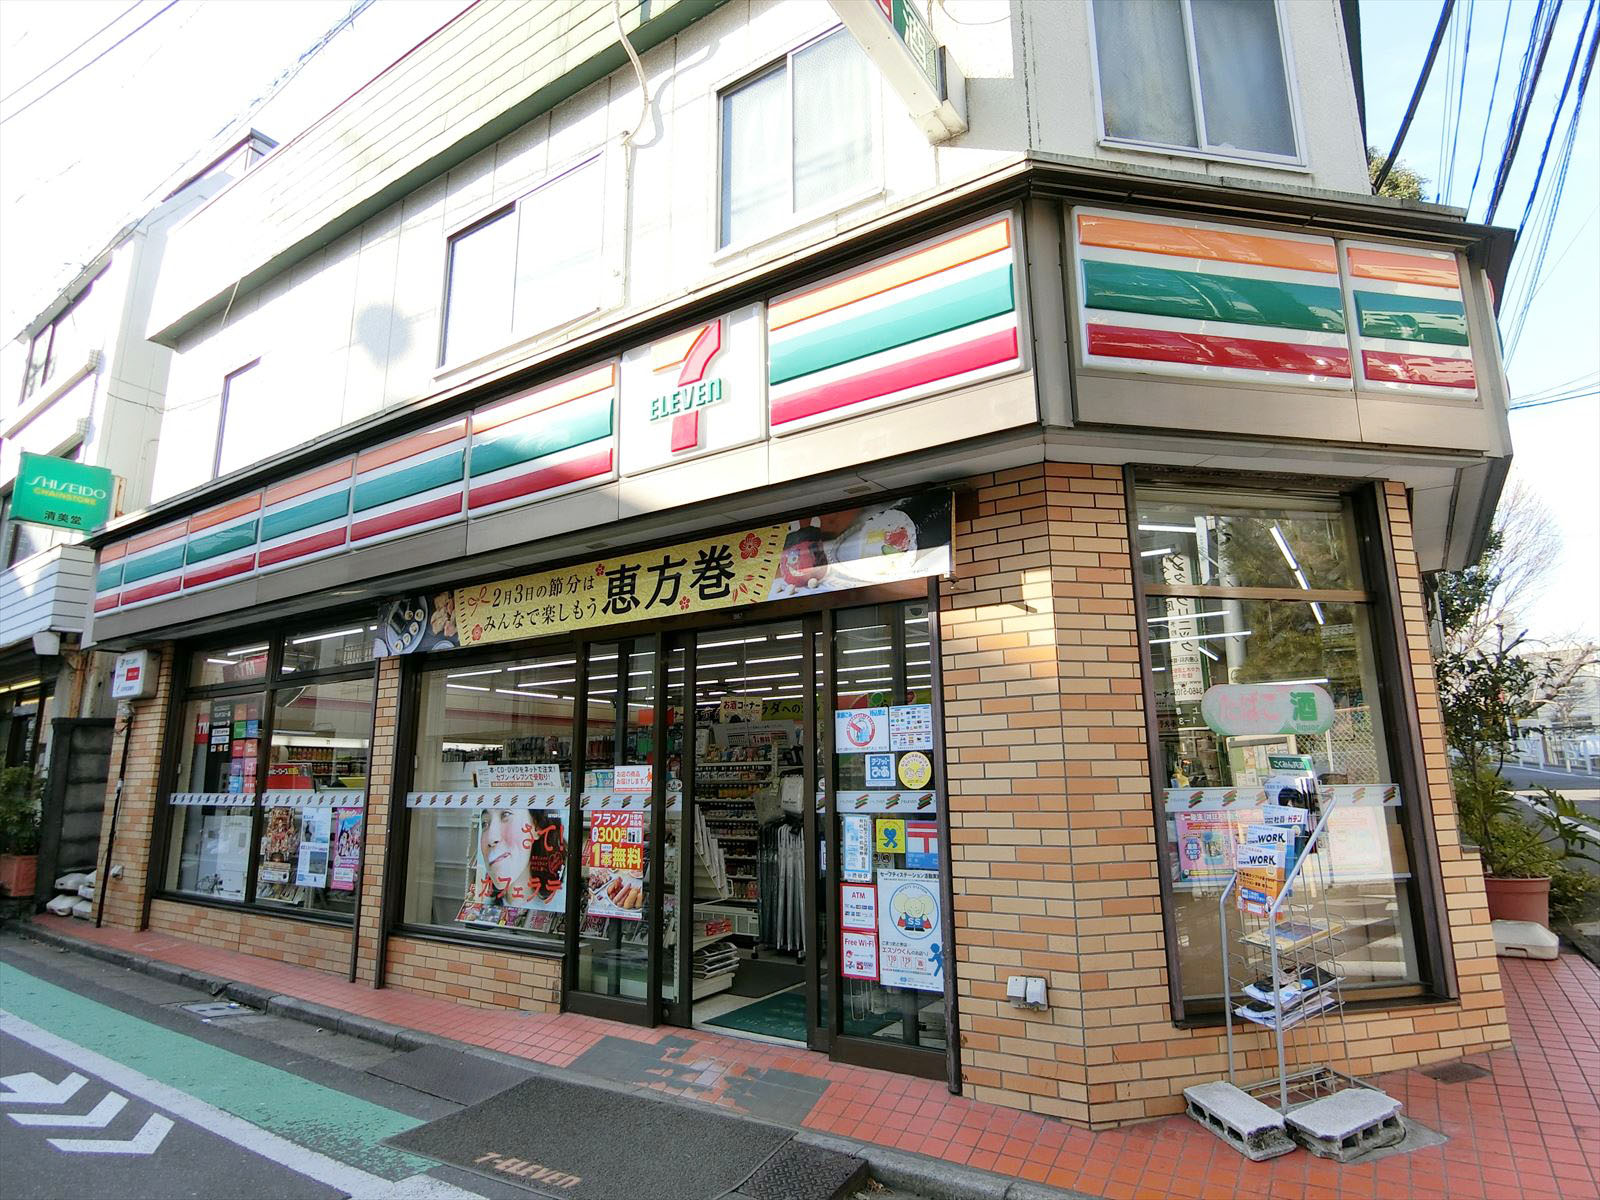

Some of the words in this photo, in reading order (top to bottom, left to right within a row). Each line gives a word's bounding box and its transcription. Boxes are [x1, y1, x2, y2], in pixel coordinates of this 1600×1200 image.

[25, 475, 107, 499] SHISEIDO
[44, 510, 82, 526] 清美堂
[490, 574, 596, 609] 2月3日の節分は
[600, 544, 737, 616] 恵方巻
[483, 599, 599, 633] みんなで楽しもう
[1218, 692, 1280, 722] たばこ
[1289, 691, 1318, 721] 酒
[871, 765, 890, 778] ぴあ
[592, 813, 630, 827] フランク
[1257, 833, 1286, 844] WORK
[1248, 855, 1277, 866] WORK
[478, 872, 563, 905] カフェラテ
